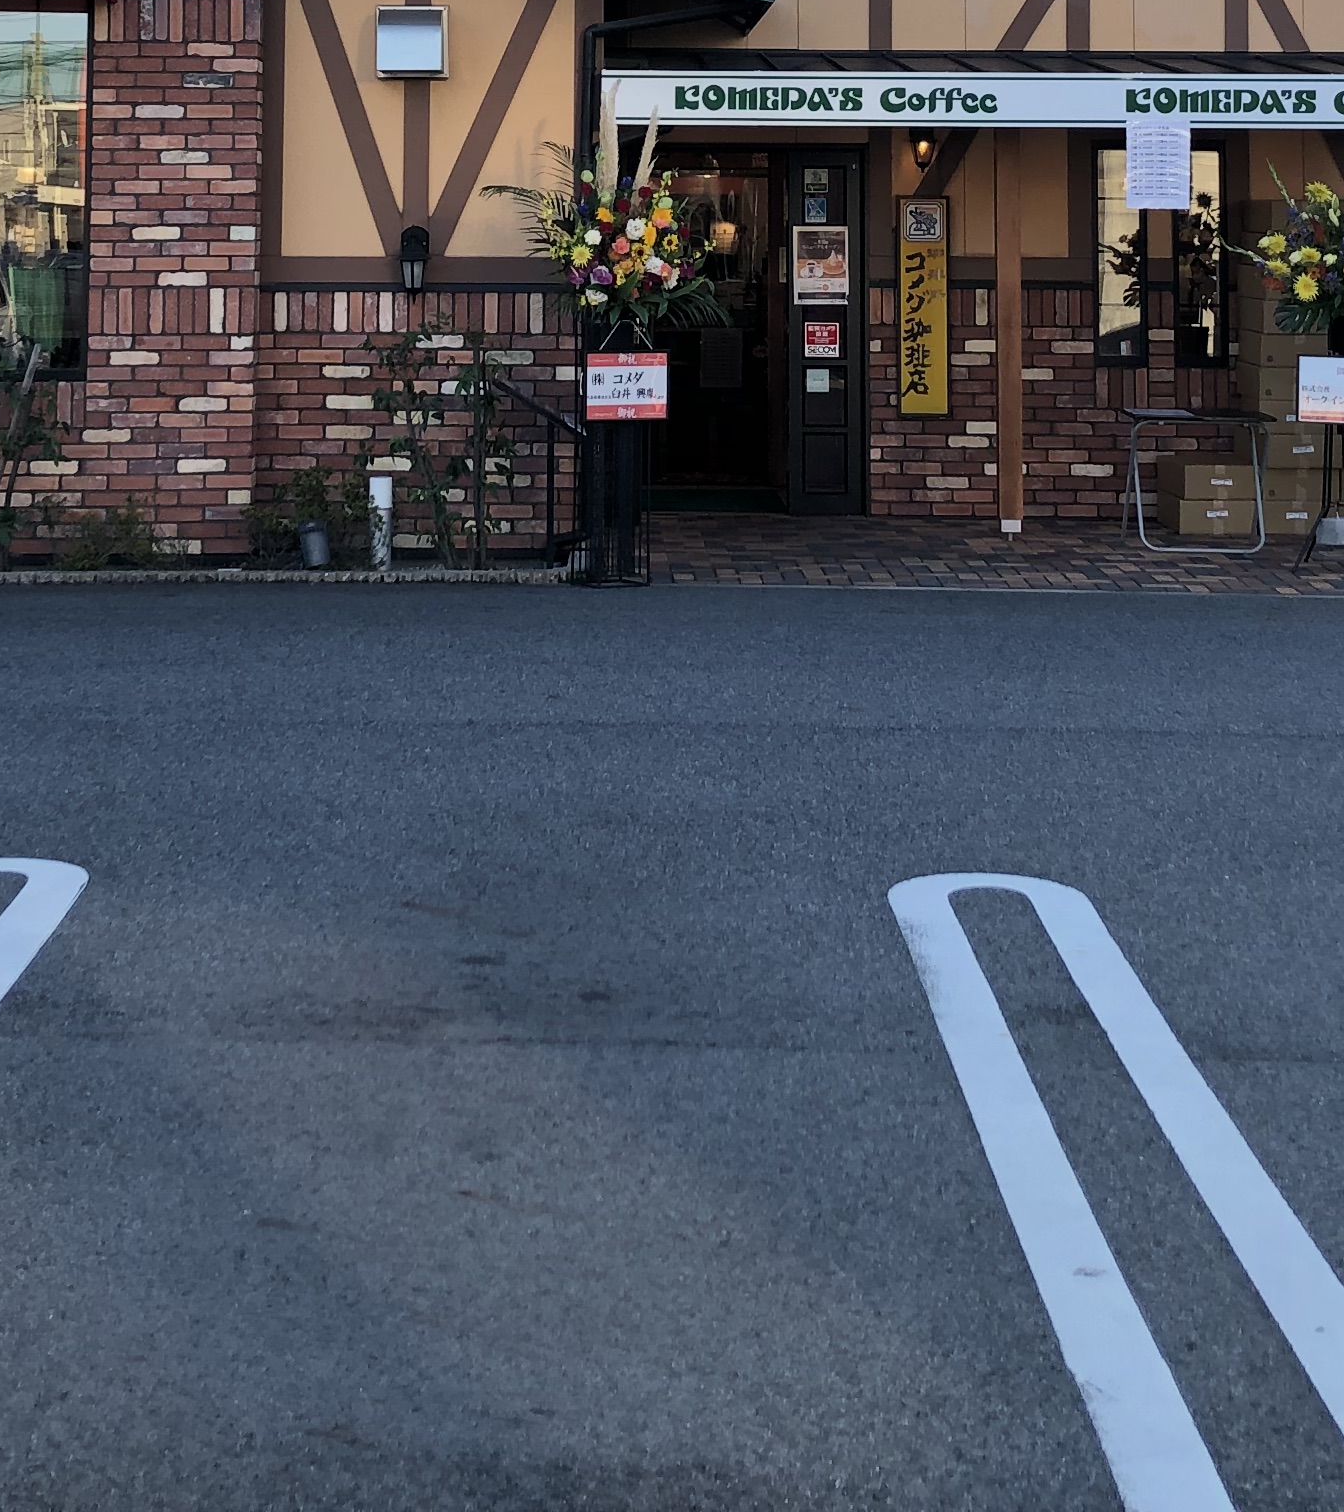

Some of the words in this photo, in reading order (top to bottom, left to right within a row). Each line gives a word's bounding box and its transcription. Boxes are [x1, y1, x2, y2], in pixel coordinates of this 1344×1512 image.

[675, 84, 863, 113] KOMEDA'S
[880, 86, 999, 114] Coffee
[1126, 87, 1317, 114] KOMEDA'S
[902, 252, 932, 398] コメダ珈琲店
[807, 346, 836, 354] SECOM
[613, 371, 644, 385] コメダ
